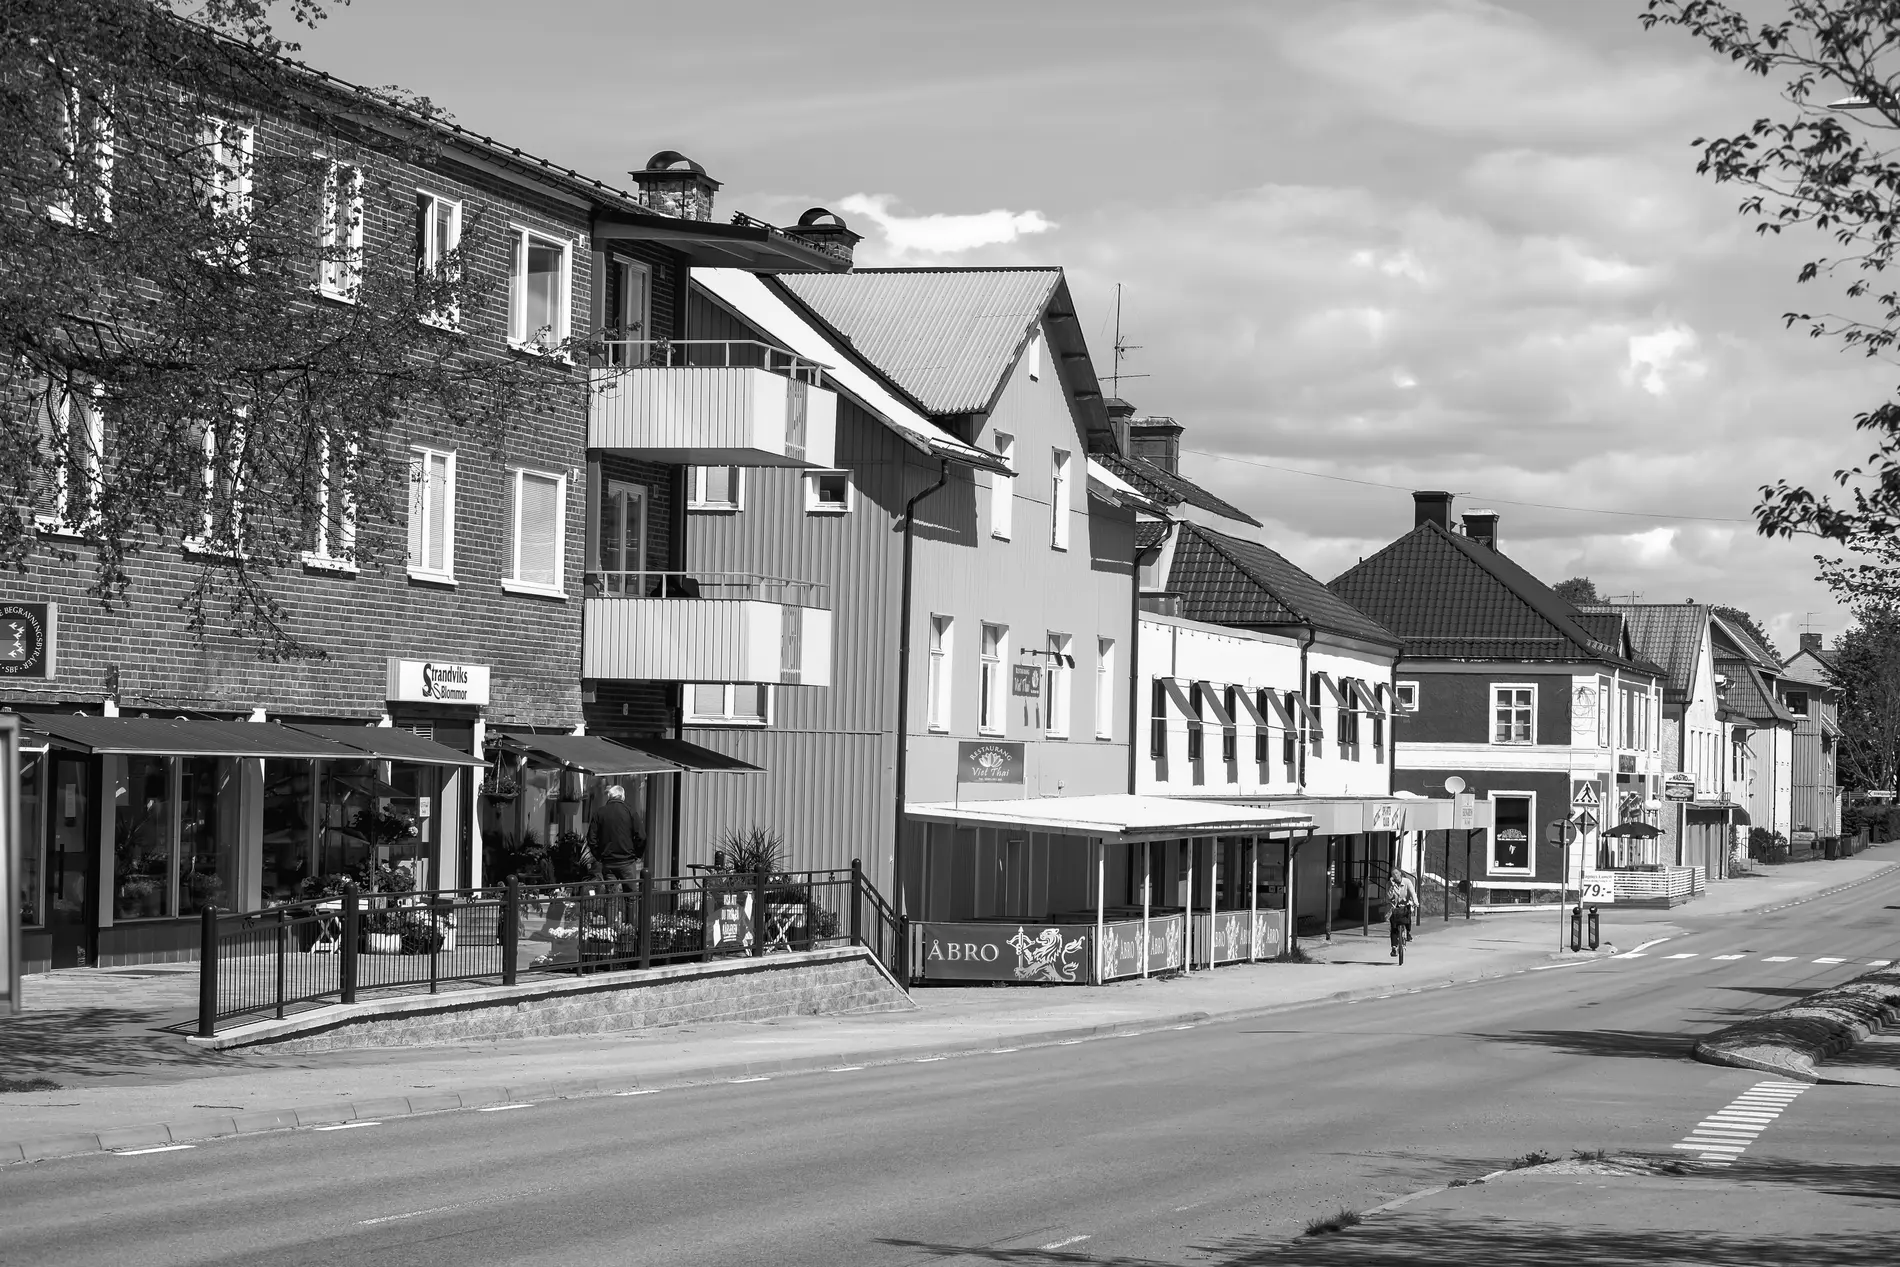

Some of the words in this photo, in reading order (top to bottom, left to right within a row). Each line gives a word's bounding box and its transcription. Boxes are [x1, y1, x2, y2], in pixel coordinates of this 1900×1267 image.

[4, 606, 43, 669] BEGRAVNINGSBYRÅER
[422, 663, 468, 697] Strandviks
[441, 686, 468, 700] Blommor
[970, 745, 1012, 761] RESTAURANG
[972, 767, 988, 776] Viet
[991, 766, 1010, 777] Thai
[1583, 884, 1612, 897] 79:-
[927, 939, 1000, 962] ÅBRO
